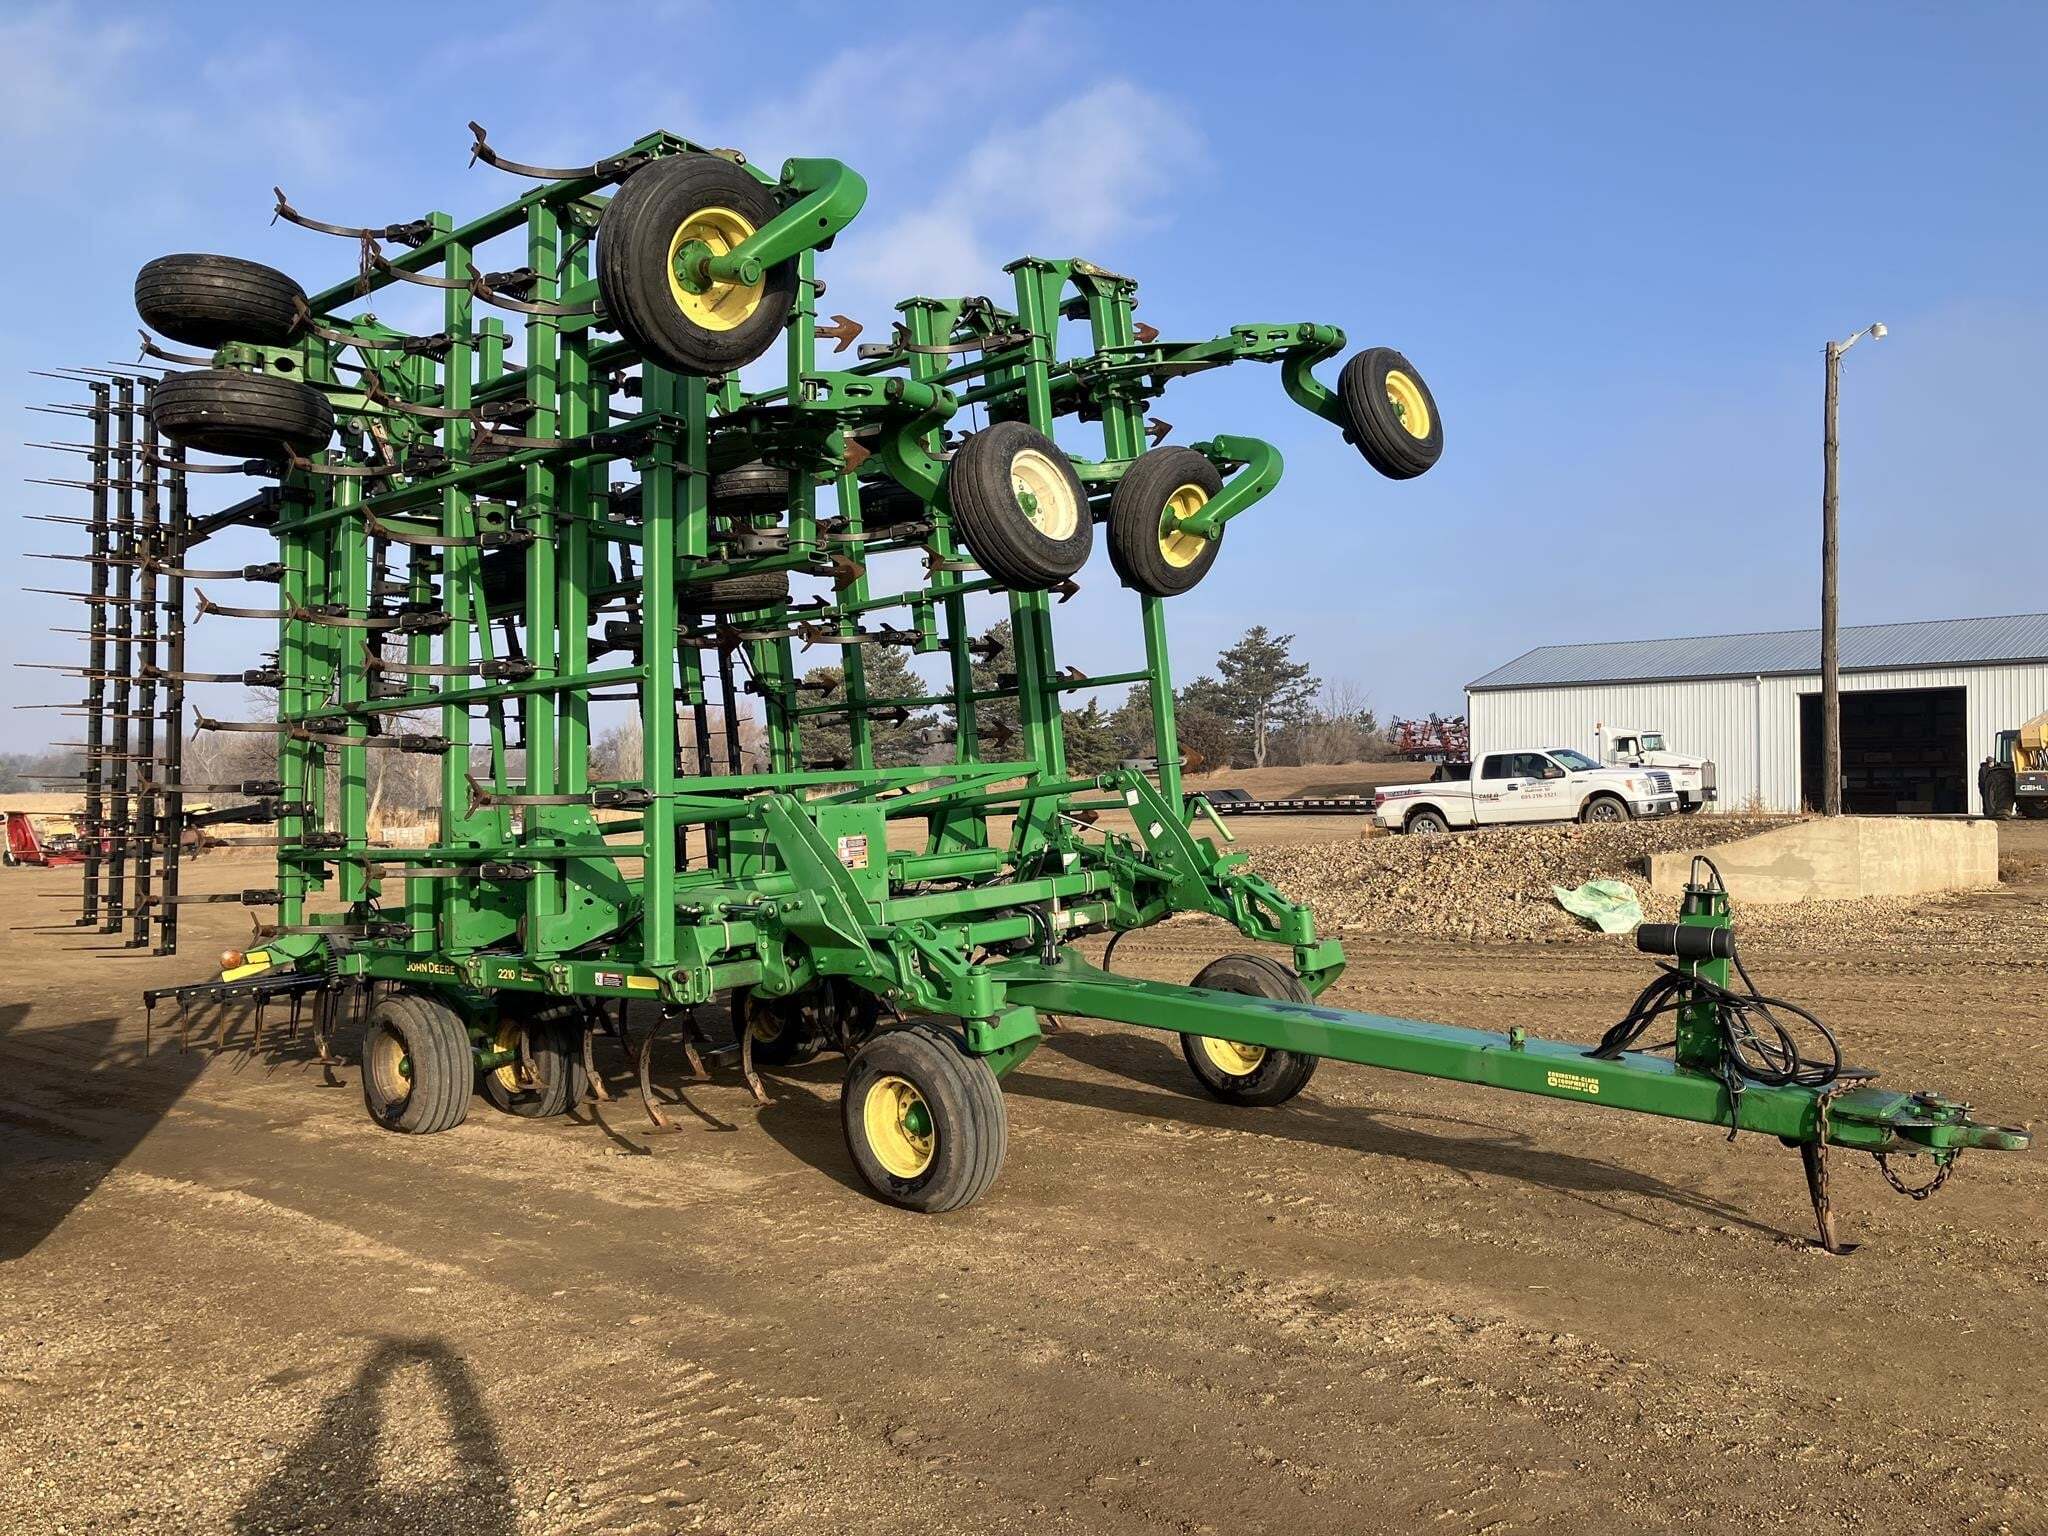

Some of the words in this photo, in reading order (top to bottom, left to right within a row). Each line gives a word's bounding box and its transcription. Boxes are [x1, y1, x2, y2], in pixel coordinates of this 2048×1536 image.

[406, 960, 428, 973] JOHN
[428, 961, 456, 976] DEERE
[497, 968, 516, 980] 2210
[1557, 1077, 1589, 1088] EQUIPMENT
